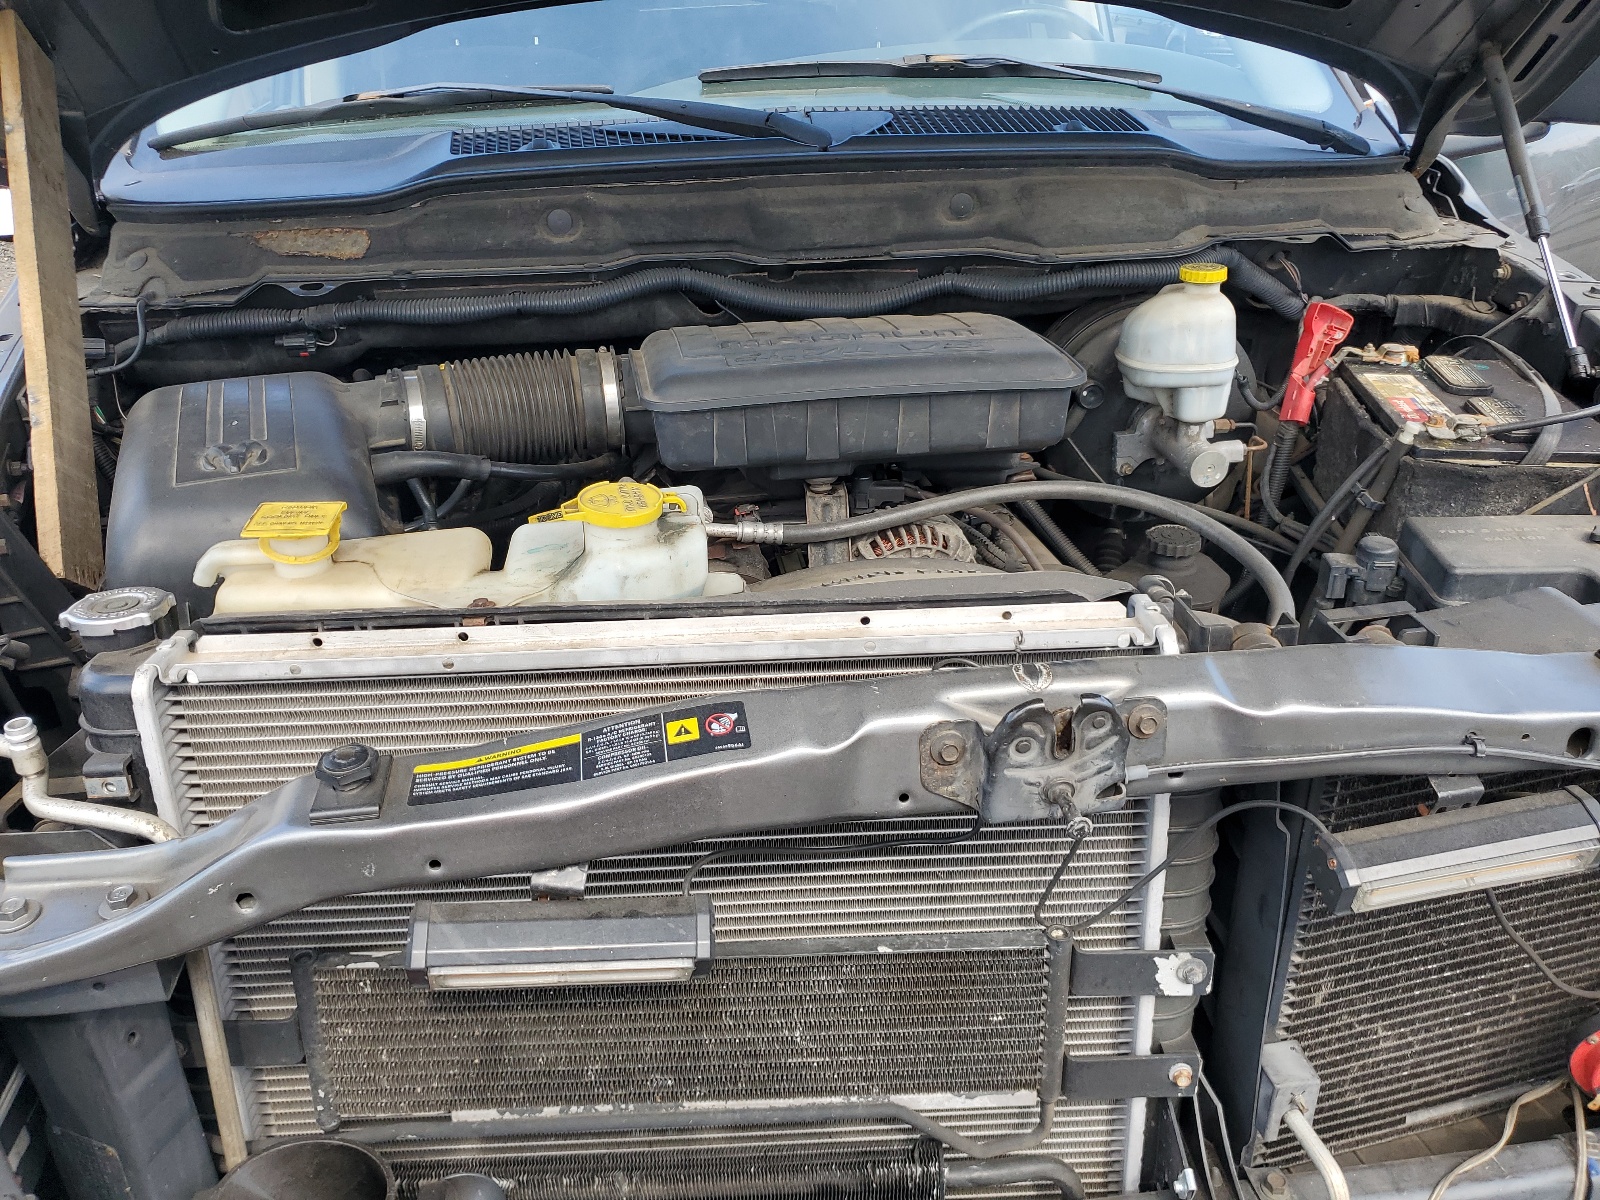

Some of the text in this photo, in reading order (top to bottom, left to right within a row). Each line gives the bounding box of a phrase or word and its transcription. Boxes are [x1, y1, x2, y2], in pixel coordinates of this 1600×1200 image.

[603, 719, 641, 733] ATTENTION
[597, 734, 621, 744] FACTORY
[484, 749, 521, 760] WARNING
[598, 747, 637, 760] COMPRESSOR
[469, 758, 513, 772] REFRIGERANT
[513, 753, 536, 761] SYSTEM
[415, 775, 446, 783] SERVICED
[458, 768, 491, 779] QUALIFIED
[491, 760, 528, 771] PERSONNEL
